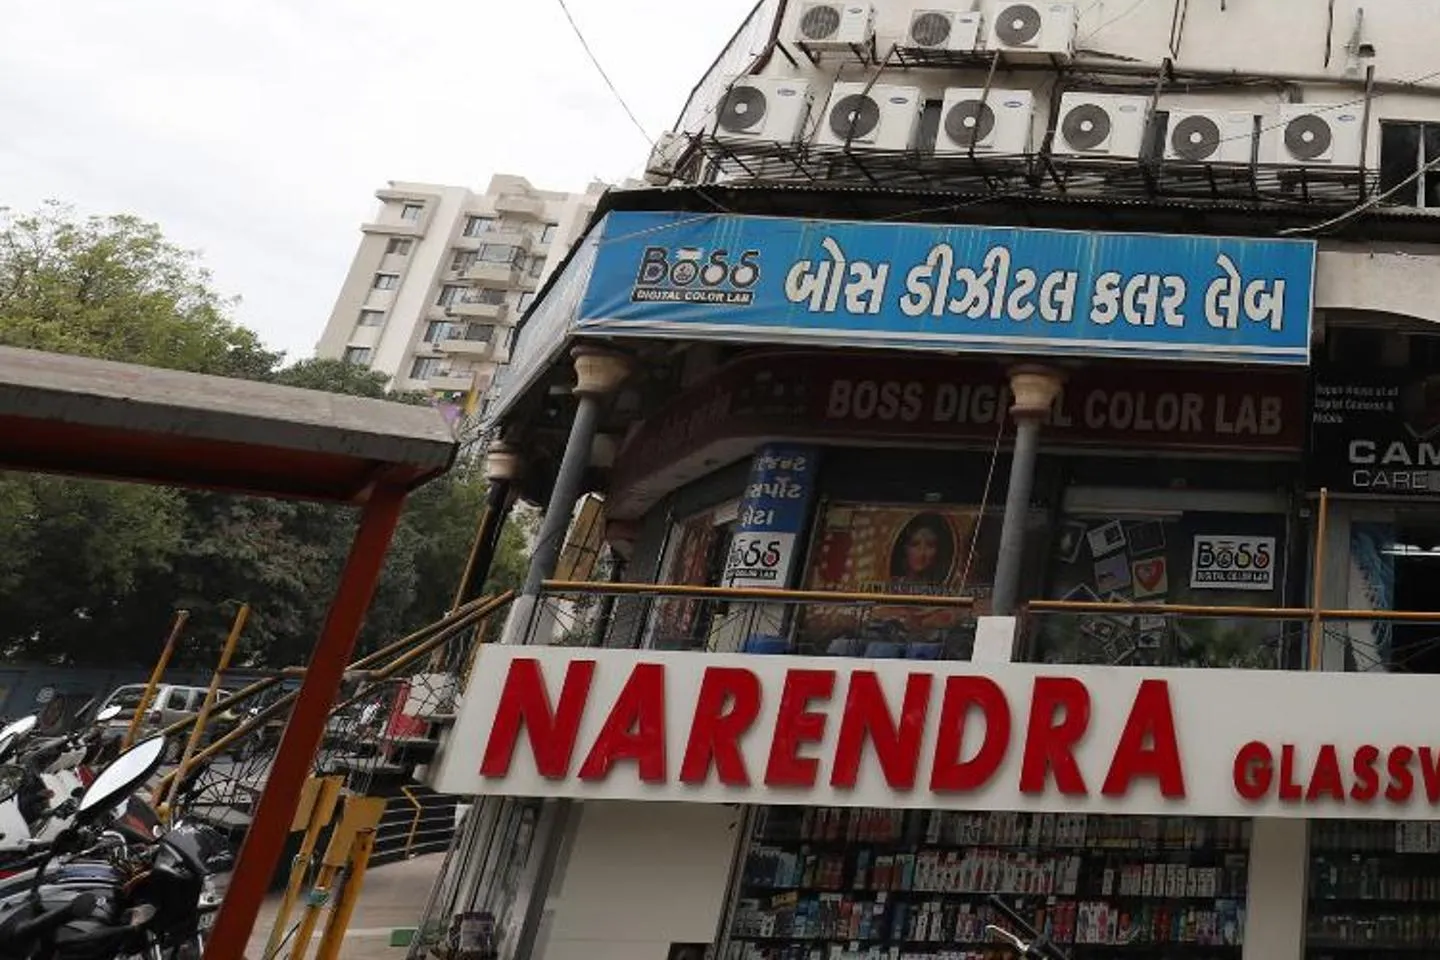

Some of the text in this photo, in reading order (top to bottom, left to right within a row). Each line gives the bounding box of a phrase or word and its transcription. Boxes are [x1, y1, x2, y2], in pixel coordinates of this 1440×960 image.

[637, 290, 750, 302] DIGITAL COLOR LAB
[783, 237, 1286, 331] બોસ ડીઝીટલ કલર લેબ
[826, 380, 1284, 436] BOSS DIGIL COLOR LAB
[1352, 469, 1427, 489] CARE
[1197, 541, 1270, 569] BOSS
[481, 657, 1187, 799] NARENDRA
